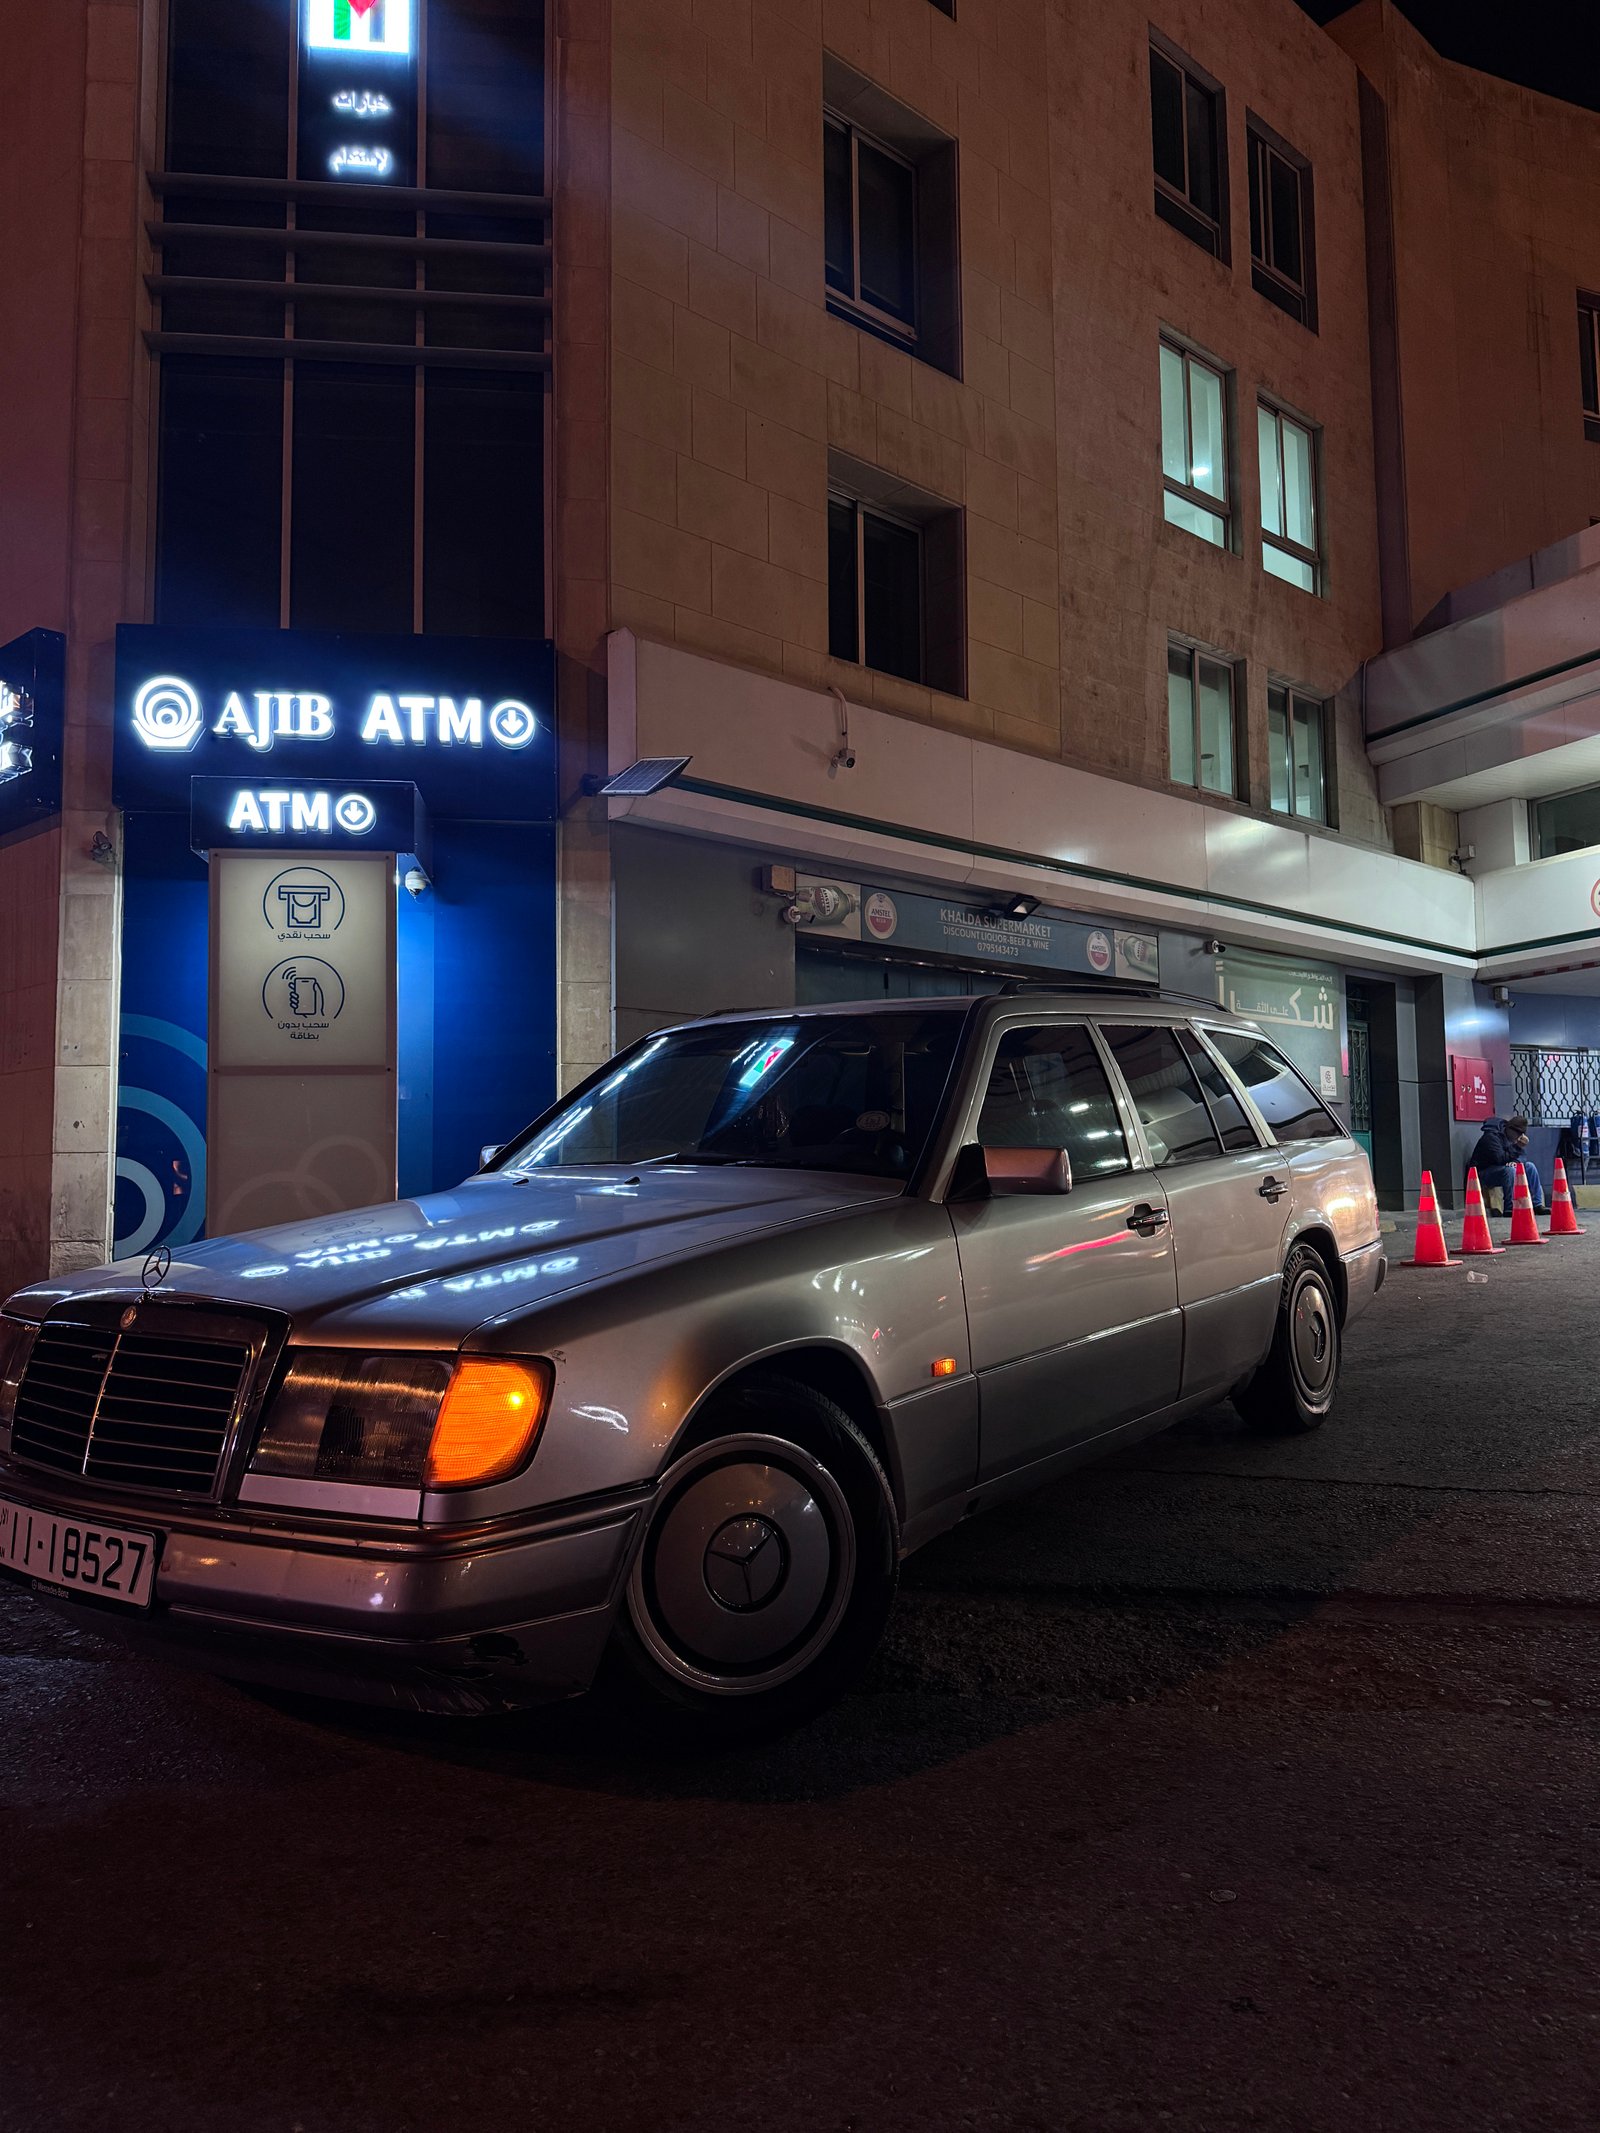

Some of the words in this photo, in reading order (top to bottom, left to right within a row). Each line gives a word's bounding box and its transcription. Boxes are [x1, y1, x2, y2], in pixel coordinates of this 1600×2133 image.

[333, 91, 391, 115] خيارات
[213, 692, 334, 748] AJIB
[361, 695, 482, 744] ATM
[229, 790, 329, 830] ATM
[871, 908, 891, 918] AMSTEL
[940, 908, 981, 927] KHALDA
[983, 915, 1052, 938] SUPERMARKET
[277, 930, 302, 943] نقدي
[303, 932, 331, 941] سحب
[943, 926, 980, 940] DISCOUNT
[981, 932, 1026, 947] LIQUOR-BEER
[1032, 940, 1049, 950] WINE
[977, 942, 1019, 957] 0795143473
[1236, 999, 1269, 1014] الثقة
[1270, 1004, 1289, 1017] على
[277, 1020, 300, 1031] بدون
[302, 1022, 330, 1031] سحب
[290, 1031, 320, 1042] بطاقة
[37, 1582, 70, 1599] Mercedes-Benz
